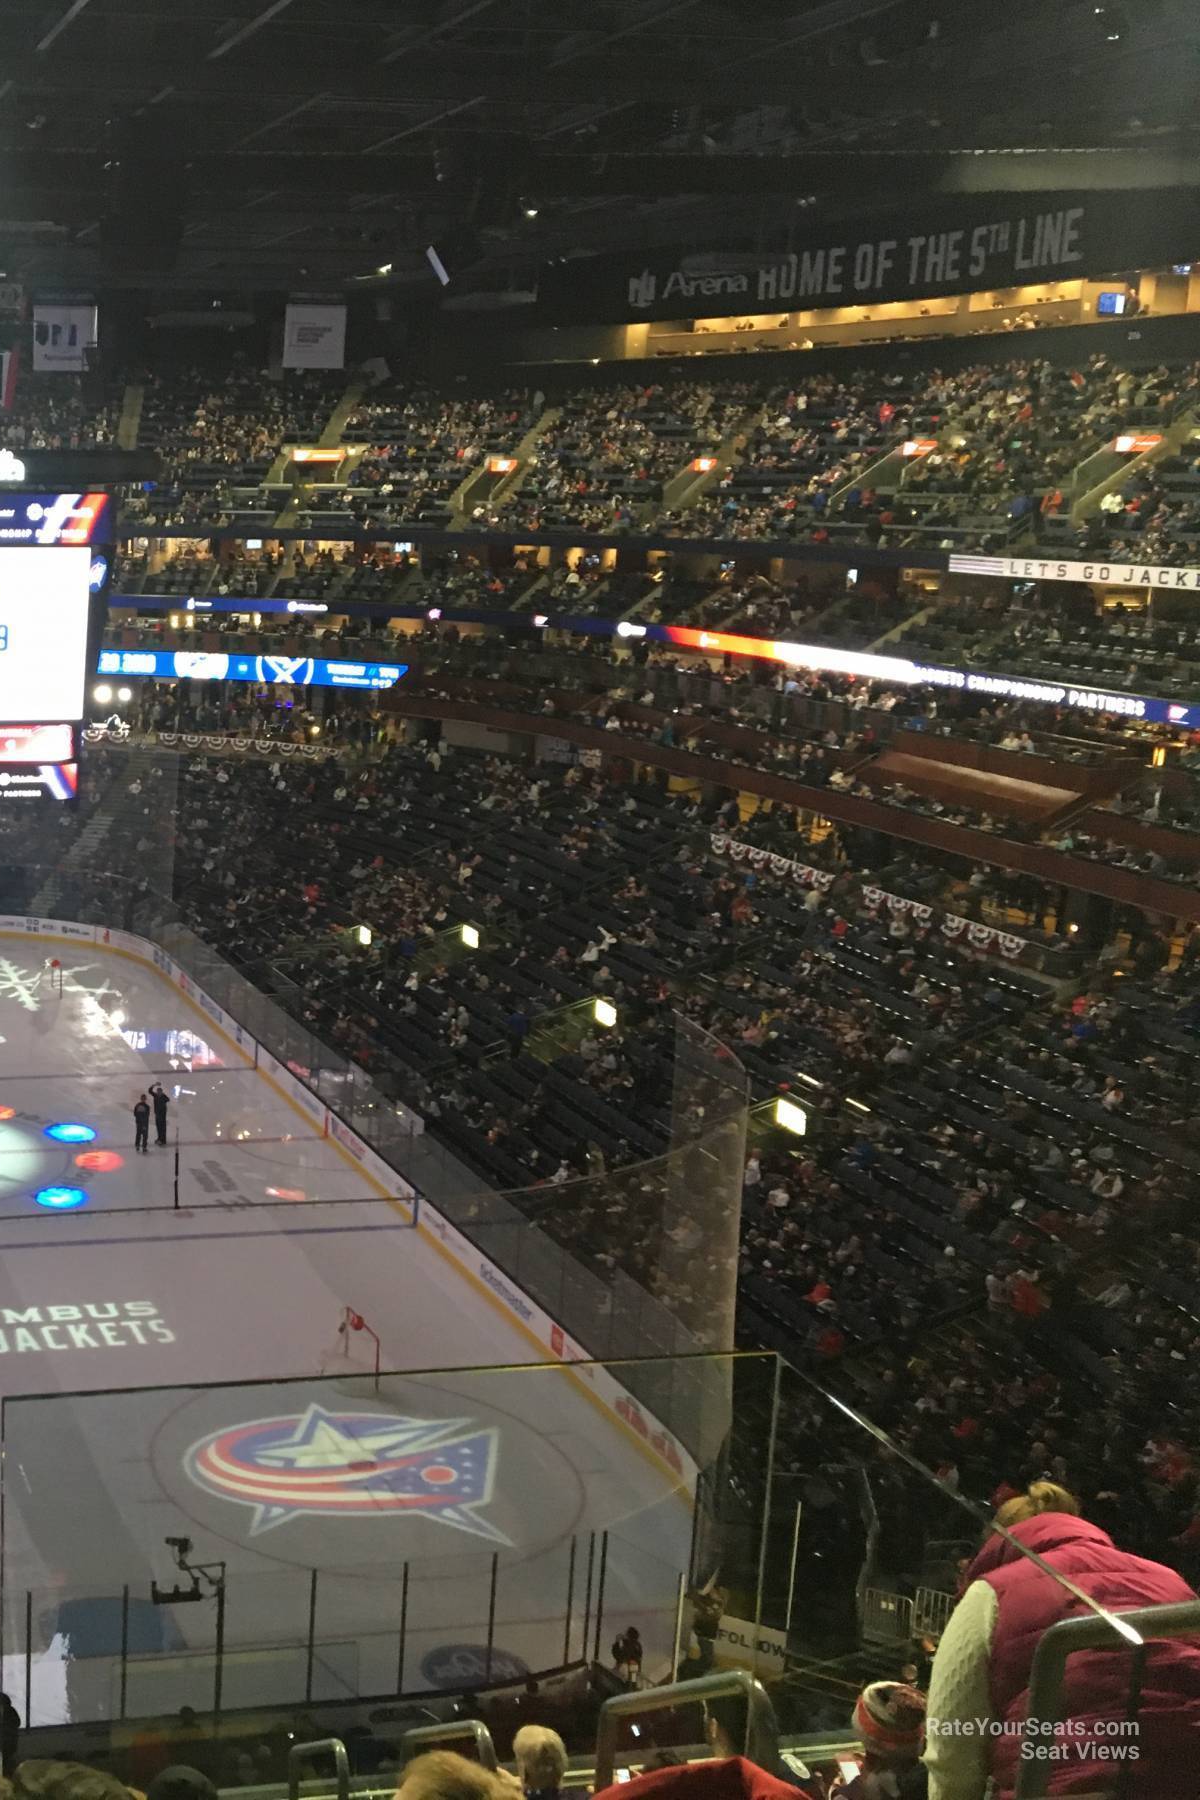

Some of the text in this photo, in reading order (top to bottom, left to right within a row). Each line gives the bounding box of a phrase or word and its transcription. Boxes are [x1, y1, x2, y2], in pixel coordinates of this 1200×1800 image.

[756, 246, 846, 300] HOME
[853, 241, 898, 290] OF
[907, 230, 965, 285] THE
[1013, 208, 1086, 271] LINE
[662, 271, 748, 298] Arena
[1083, 566, 1110, 580] GO
[1068, 689, 1146, 717] PARTNERS
